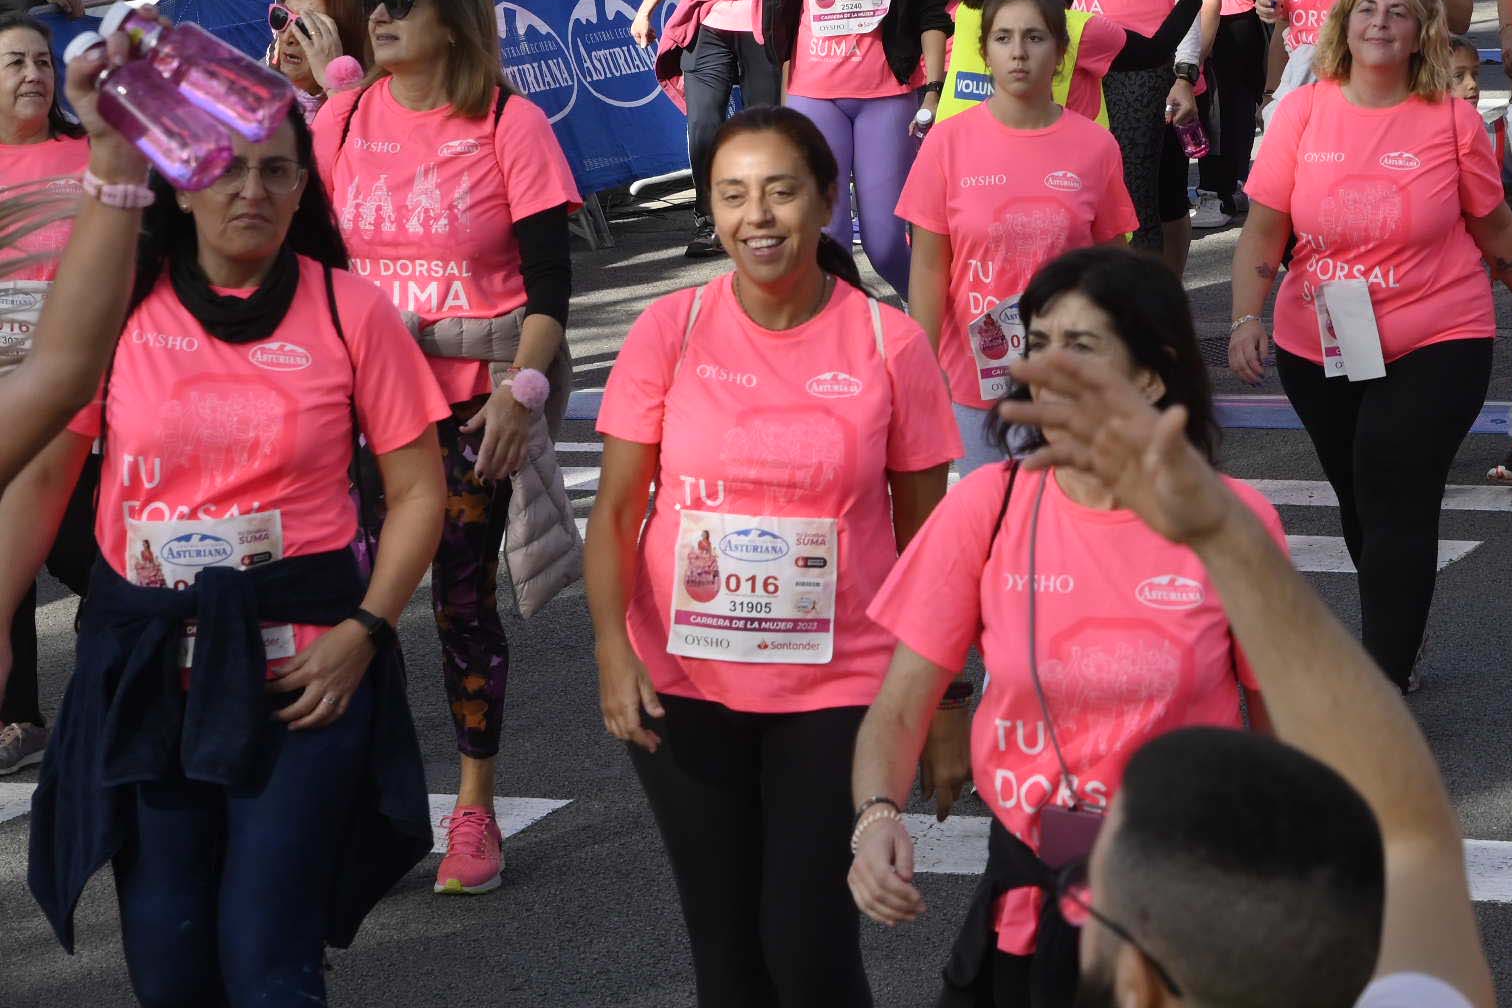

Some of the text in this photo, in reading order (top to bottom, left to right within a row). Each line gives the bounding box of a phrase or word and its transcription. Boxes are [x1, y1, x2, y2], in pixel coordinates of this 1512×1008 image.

[841, 3, 862, 11] 25240
[809, 38, 862, 56] SUMA
[354, 138, 401, 154] OYSHO
[1304, 151, 1345, 163] OYSHO
[960, 173, 1007, 189] OYSHO
[380, 259, 472, 277] DORSAL
[967, 259, 992, 285] TU
[1306, 254, 1400, 289] DORSAL
[132, 328, 199, 352] OYSHO
[254, 349, 310, 366] ASTURIANA
[696, 363, 757, 388] OYSHO
[808, 381, 859, 394] ASTURIANA
[122, 454, 162, 489] TU
[680, 475, 725, 507] TU
[724, 539, 784, 554] ASTURIANA
[795, 536, 827, 546] SUMA
[166, 543, 229, 560] ASTURIANA
[725, 573, 780, 595] 016
[728, 600, 773, 614] 31905
[690, 615, 730, 628] CARRERA
[731, 619, 746, 628] DE
[746, 620, 760, 629] LA
[760, 620, 794, 630] MUJER
[684, 633, 820, 651] OYSHO Santander
[994, 717, 1046, 755] TU
[994, 768, 1108, 814] DORS
